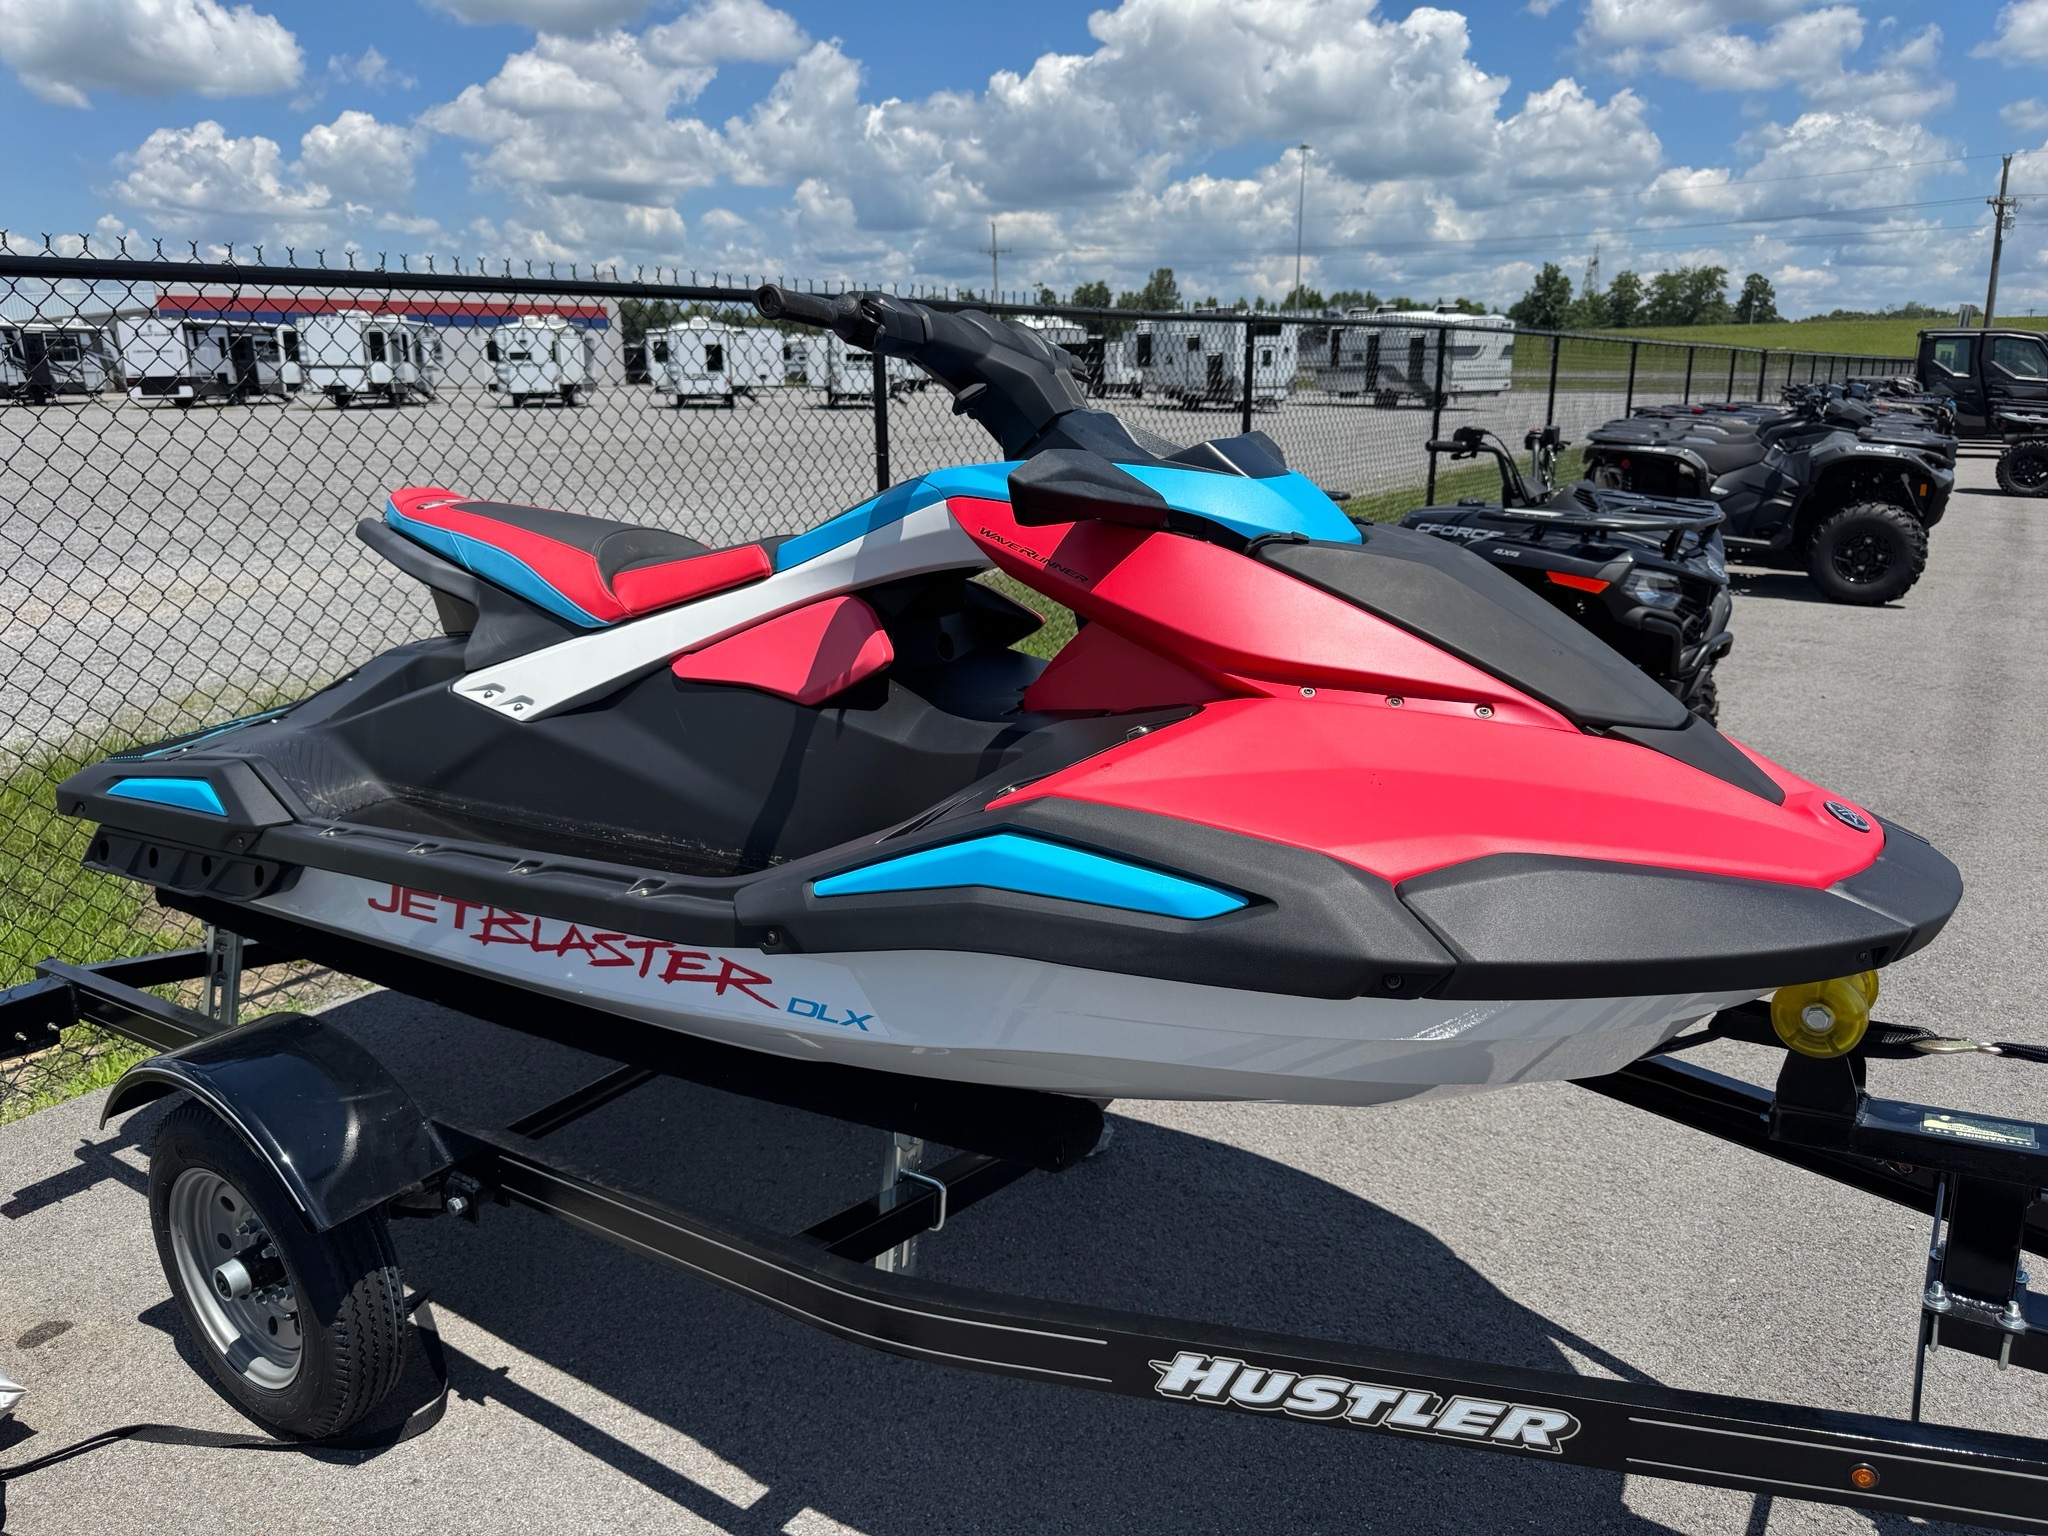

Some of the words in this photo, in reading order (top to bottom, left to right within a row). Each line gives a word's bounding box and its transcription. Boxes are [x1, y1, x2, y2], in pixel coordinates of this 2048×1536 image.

[1415, 523, 1505, 539] CFORCE
[368, 885, 780, 1010] JETBLASTER
[787, 997, 874, 1031] DLX
[1956, 1131, 2007, 1143] WARNING
[1150, 1353, 1575, 1449] HUSTLER
